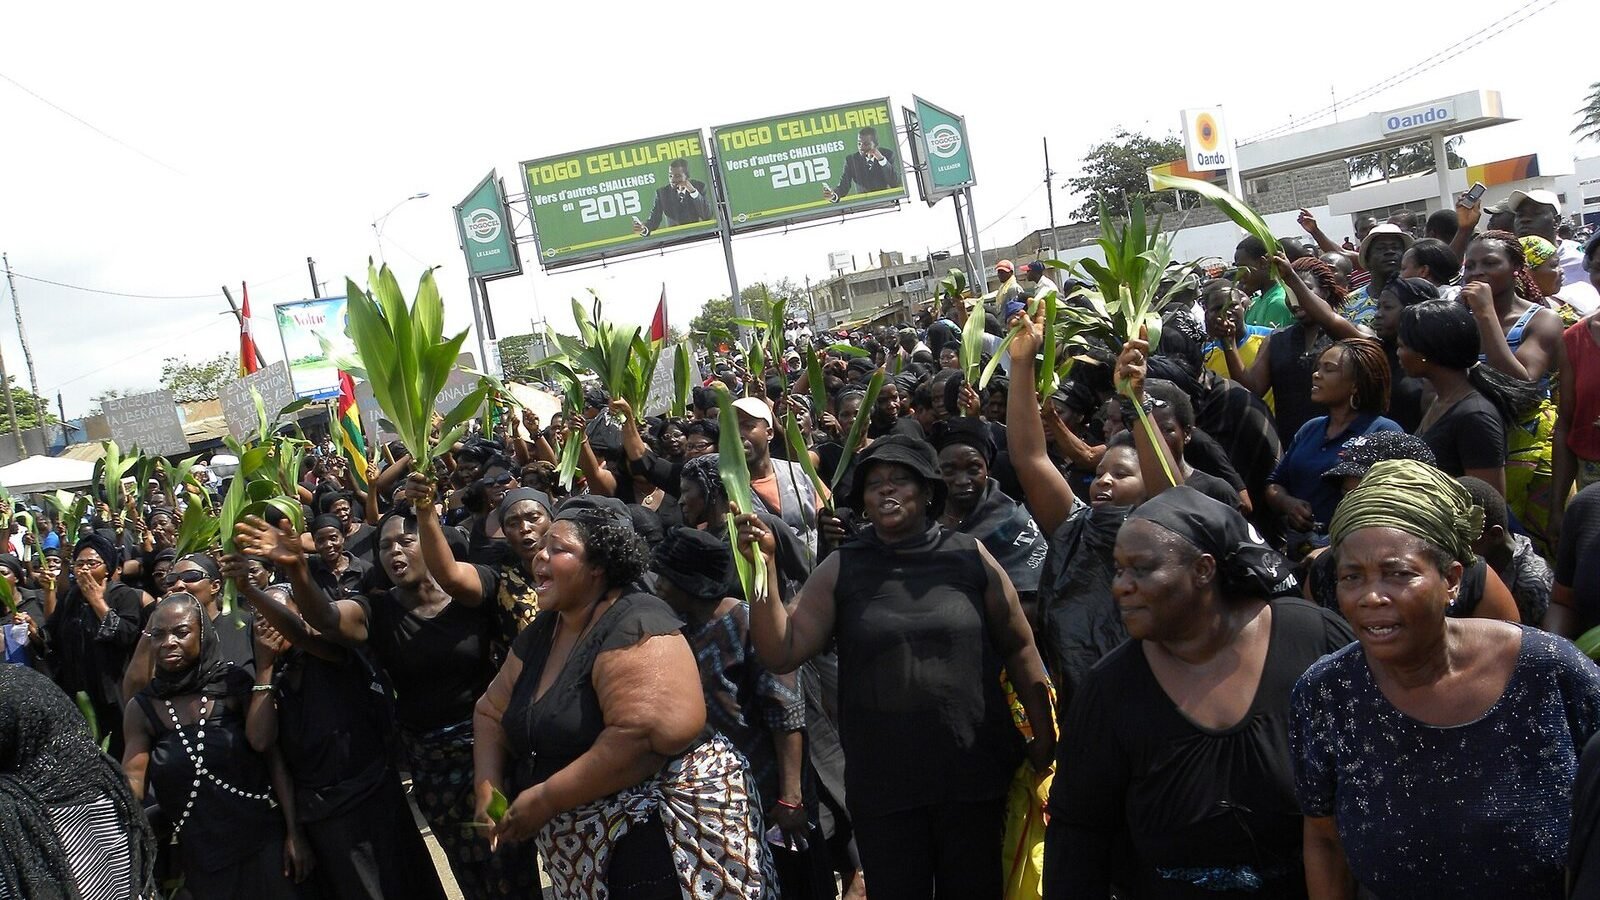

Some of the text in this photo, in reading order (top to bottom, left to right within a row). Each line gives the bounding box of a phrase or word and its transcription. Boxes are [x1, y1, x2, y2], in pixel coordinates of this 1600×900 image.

[719, 106, 889, 151] TOGO CELLULAIRE
[1387, 108, 1447, 130] Oando
[931, 135, 960, 146] TOGOCEL
[527, 138, 701, 186] TOGO CELLULAIRE
[726, 140, 845, 172] Vers d'autres CHALLENGES
[944, 162, 961, 171] LEADER
[1197, 152, 1225, 166] Oando
[753, 157, 831, 189] en 2013
[534, 173, 656, 206] Vers d'autres CHALLENGES
[562, 190, 642, 224] en 2013
[469, 220, 500, 231] TOGOCEL
[483, 248, 501, 257] LEADER
